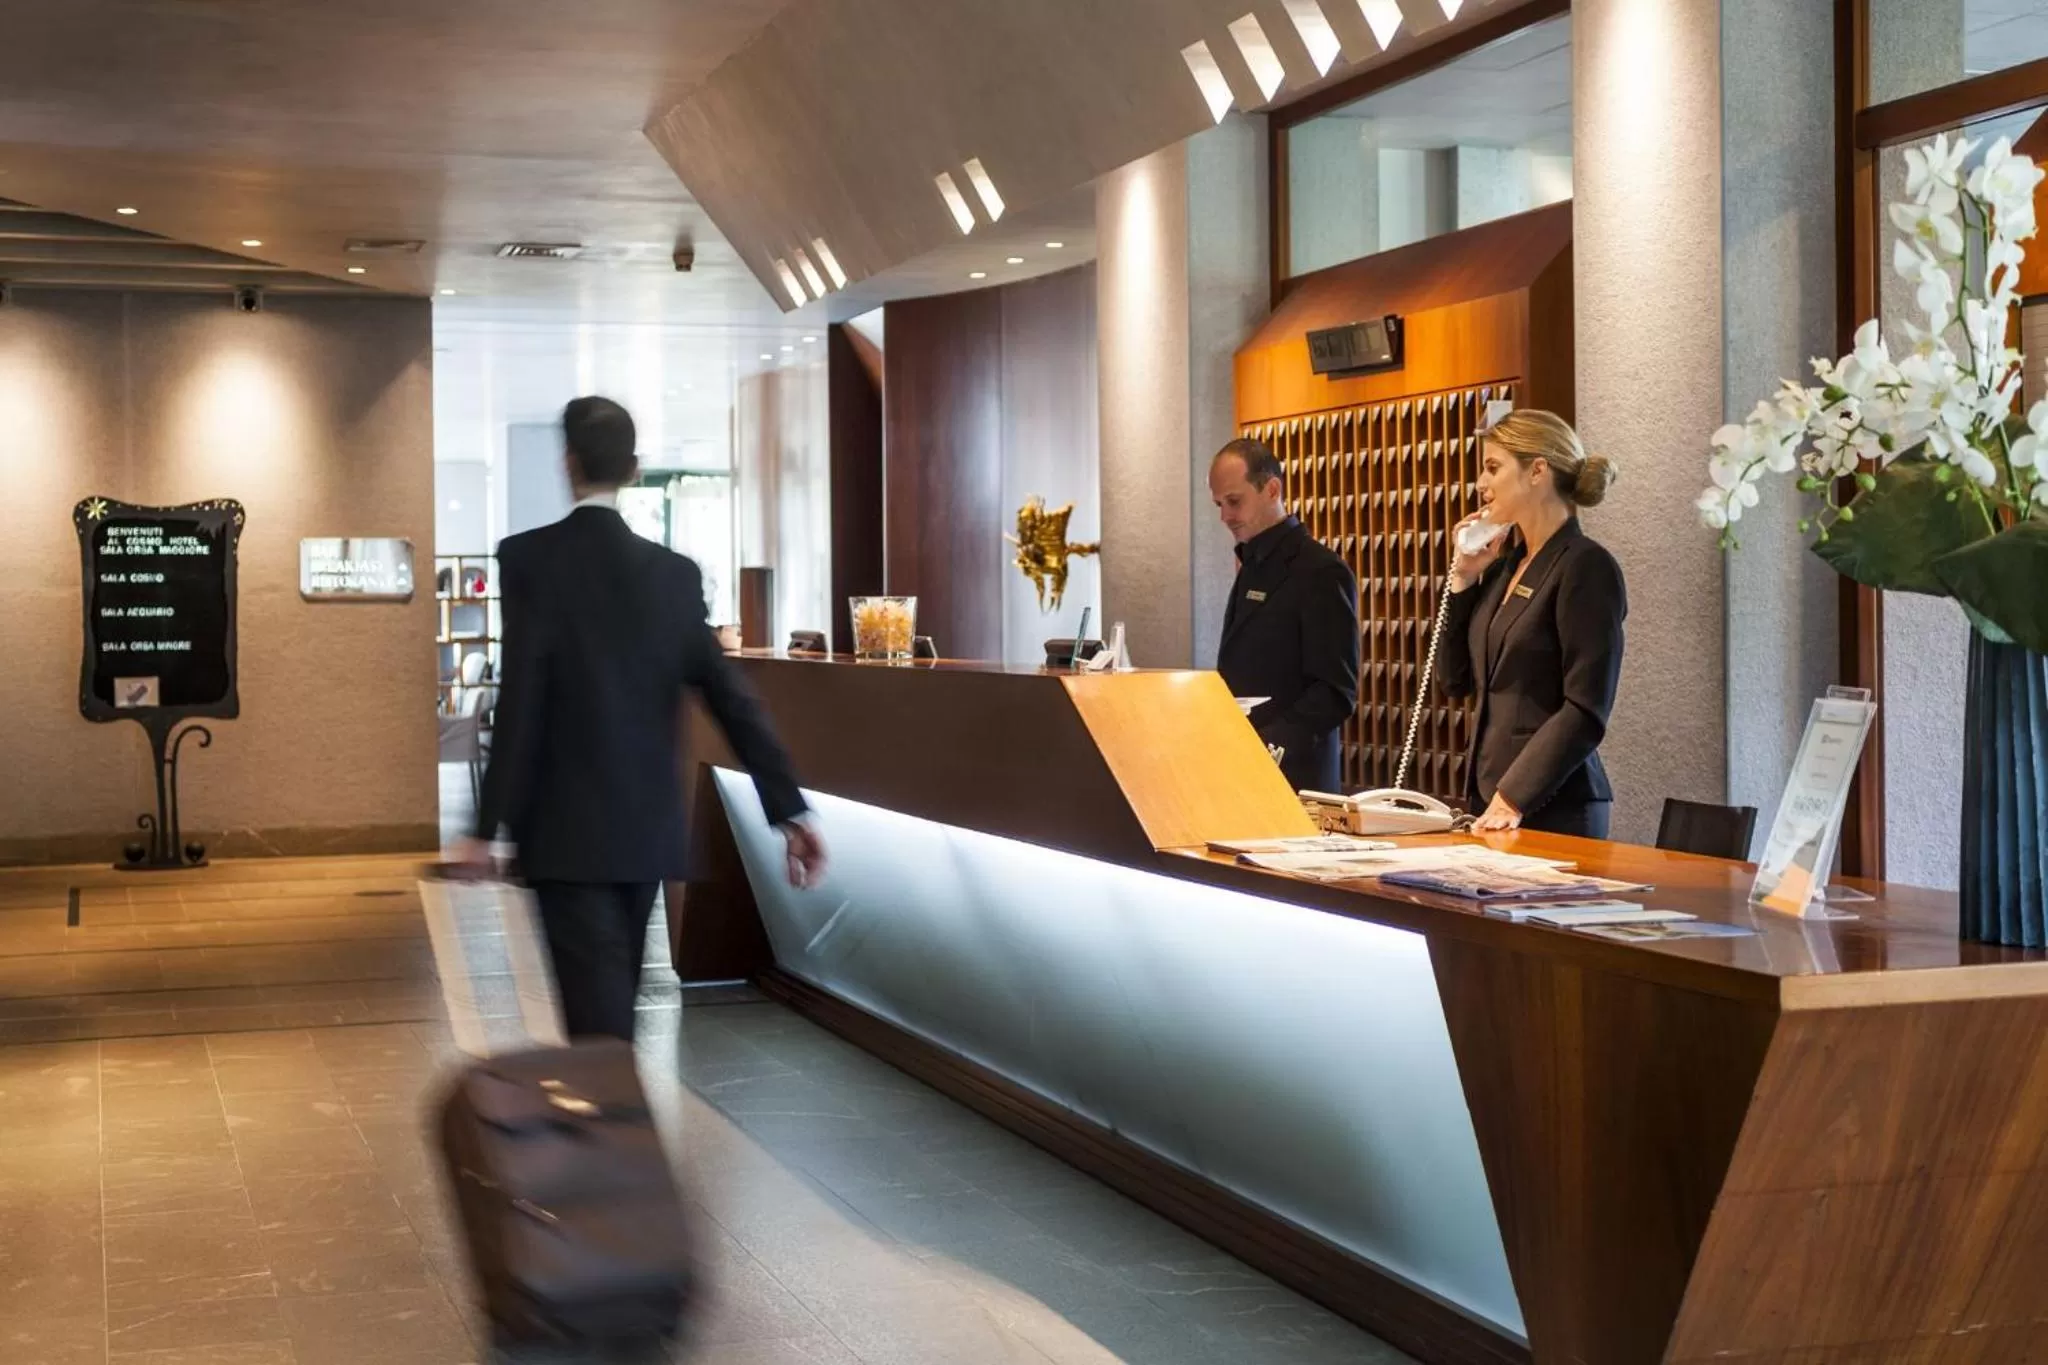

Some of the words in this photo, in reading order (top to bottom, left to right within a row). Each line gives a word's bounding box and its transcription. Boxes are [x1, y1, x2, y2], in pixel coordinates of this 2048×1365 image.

[107, 527, 163, 536] BENVENUTI
[107, 537, 119, 546] AL
[126, 537, 163, 546] COSMO
[169, 537, 201, 546] HOTEL
[100, 546, 123, 554] SALA
[126, 546, 154, 555] ORSA
[159, 546, 209, 555] MAGGIORE
[101, 574, 126, 582] SALA
[101, 608, 124, 617] SALA
[102, 642, 126, 651] SALA
